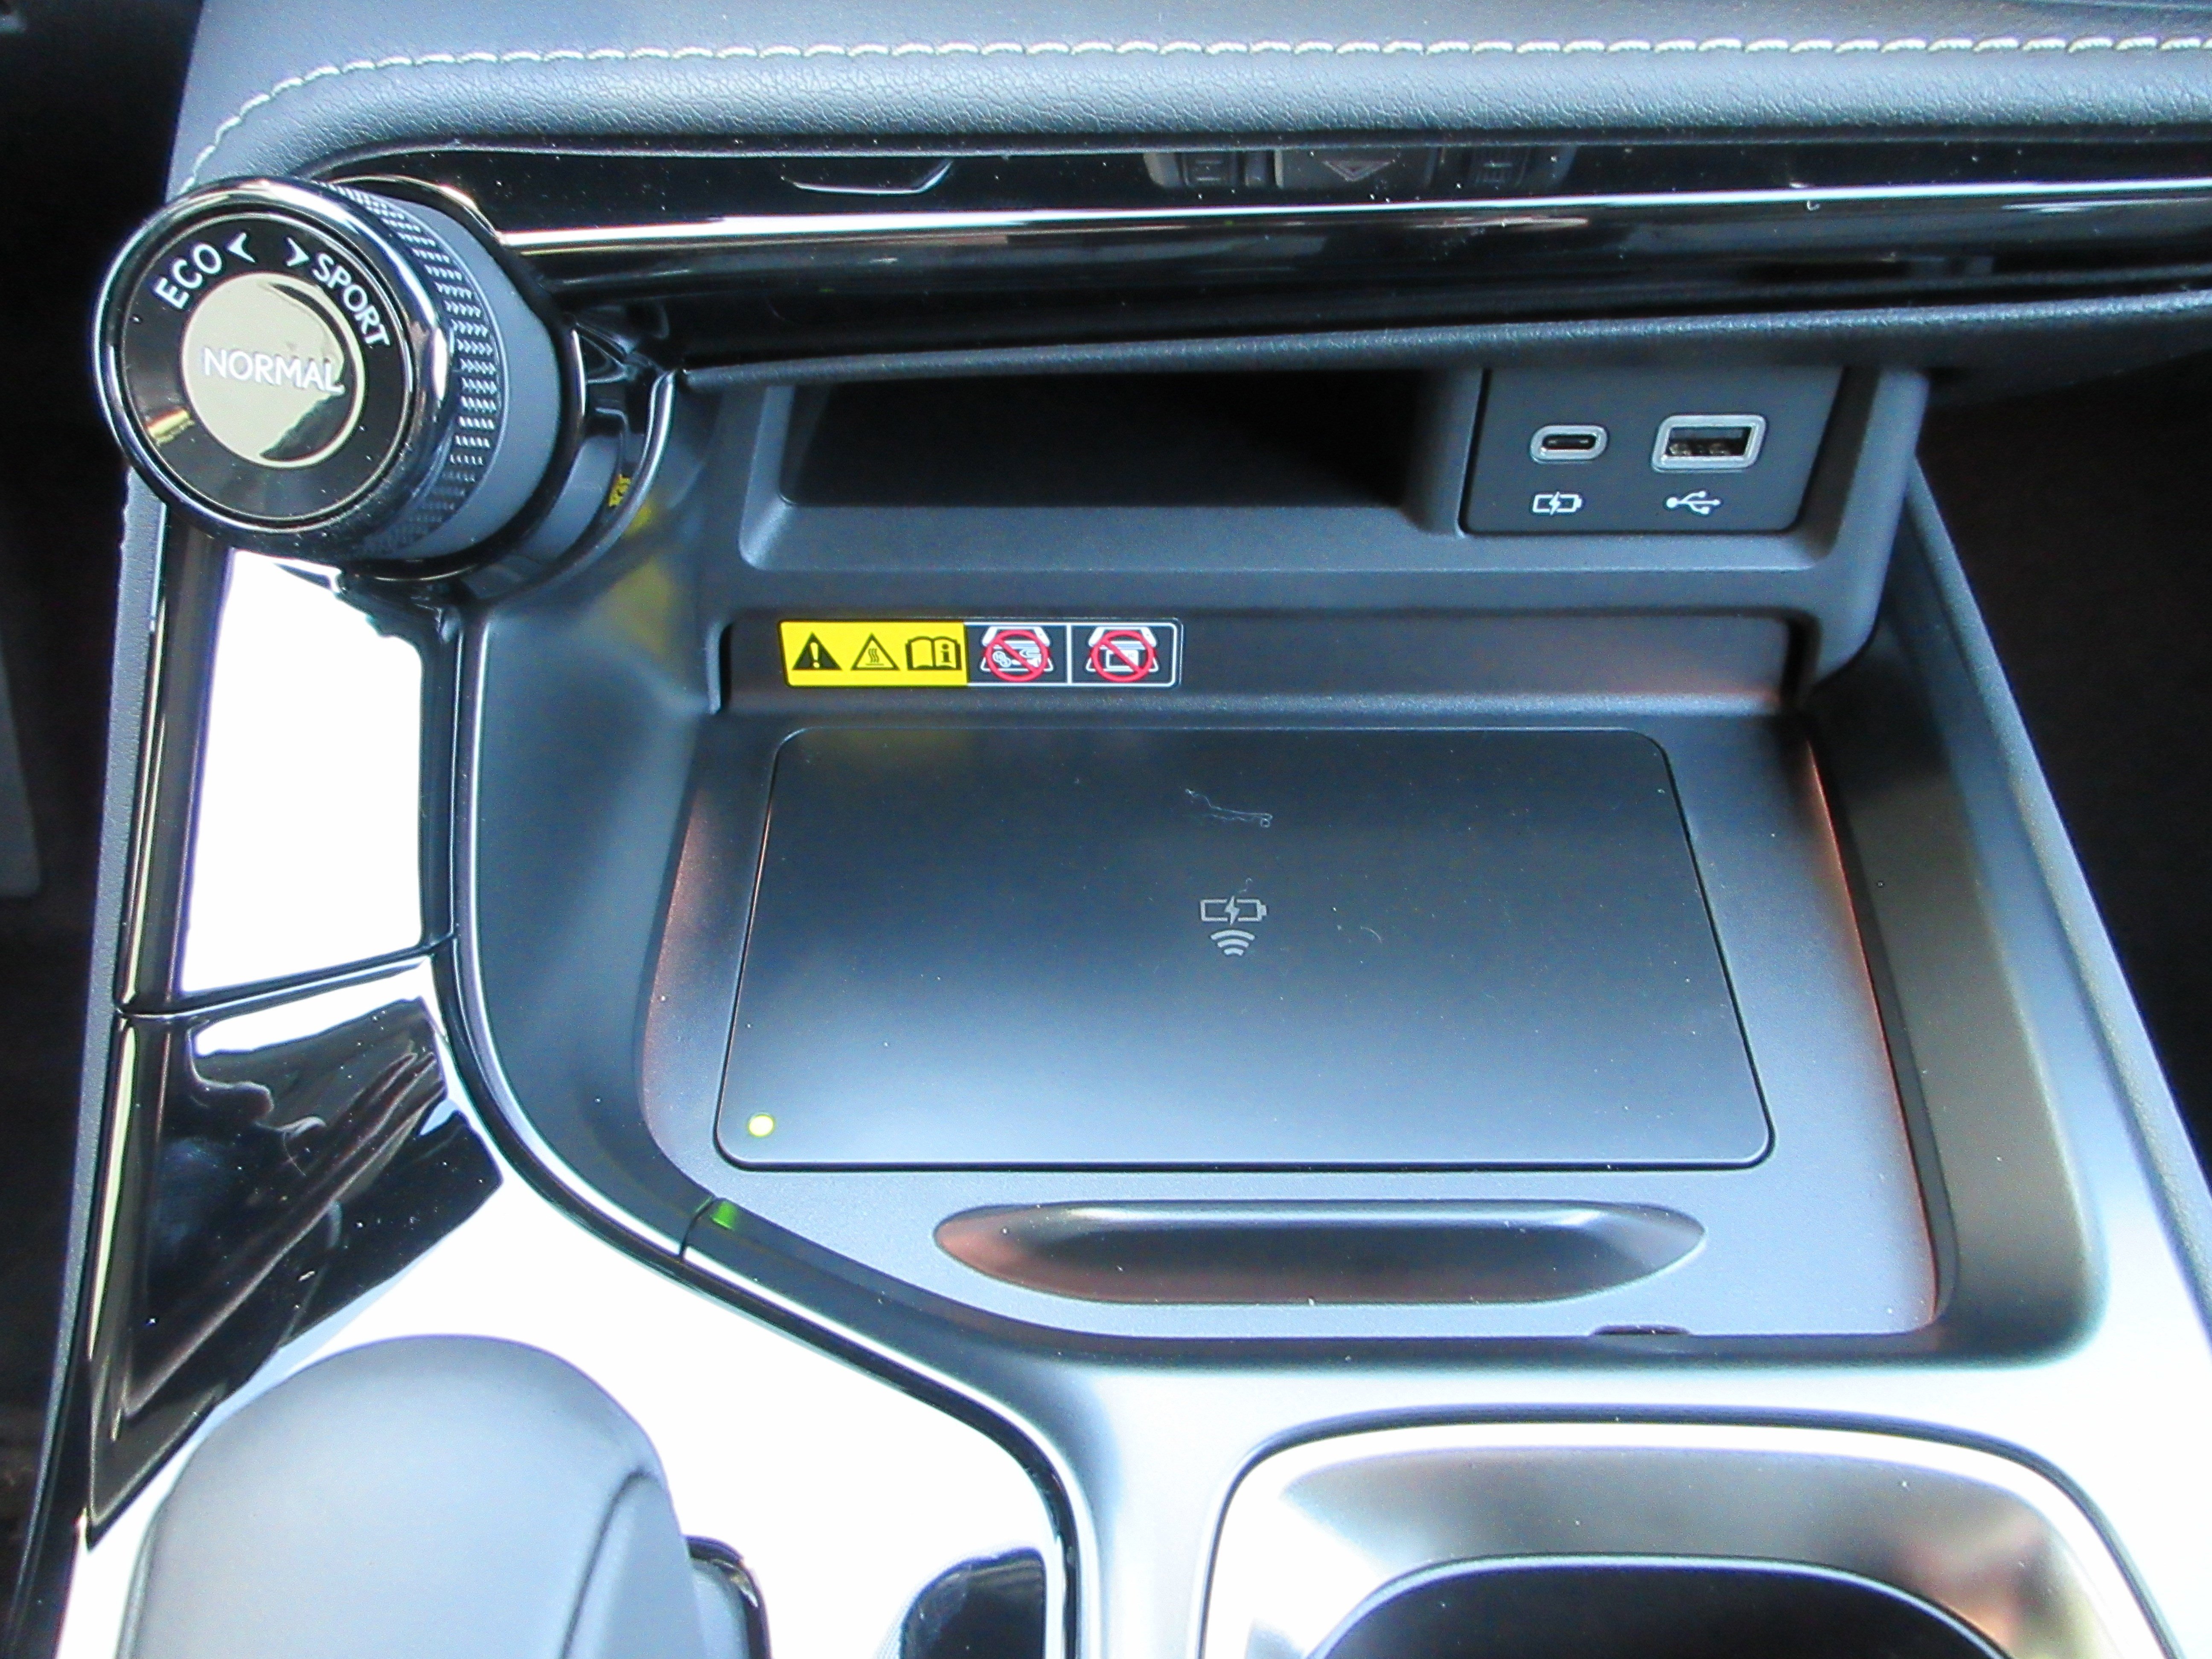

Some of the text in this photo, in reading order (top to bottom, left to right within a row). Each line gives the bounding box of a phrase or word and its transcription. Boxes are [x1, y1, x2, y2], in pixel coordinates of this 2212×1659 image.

[154, 243, 222, 309] ECO
[312, 253, 390, 346] SPORT
[204, 347, 345, 393] NORMAL
